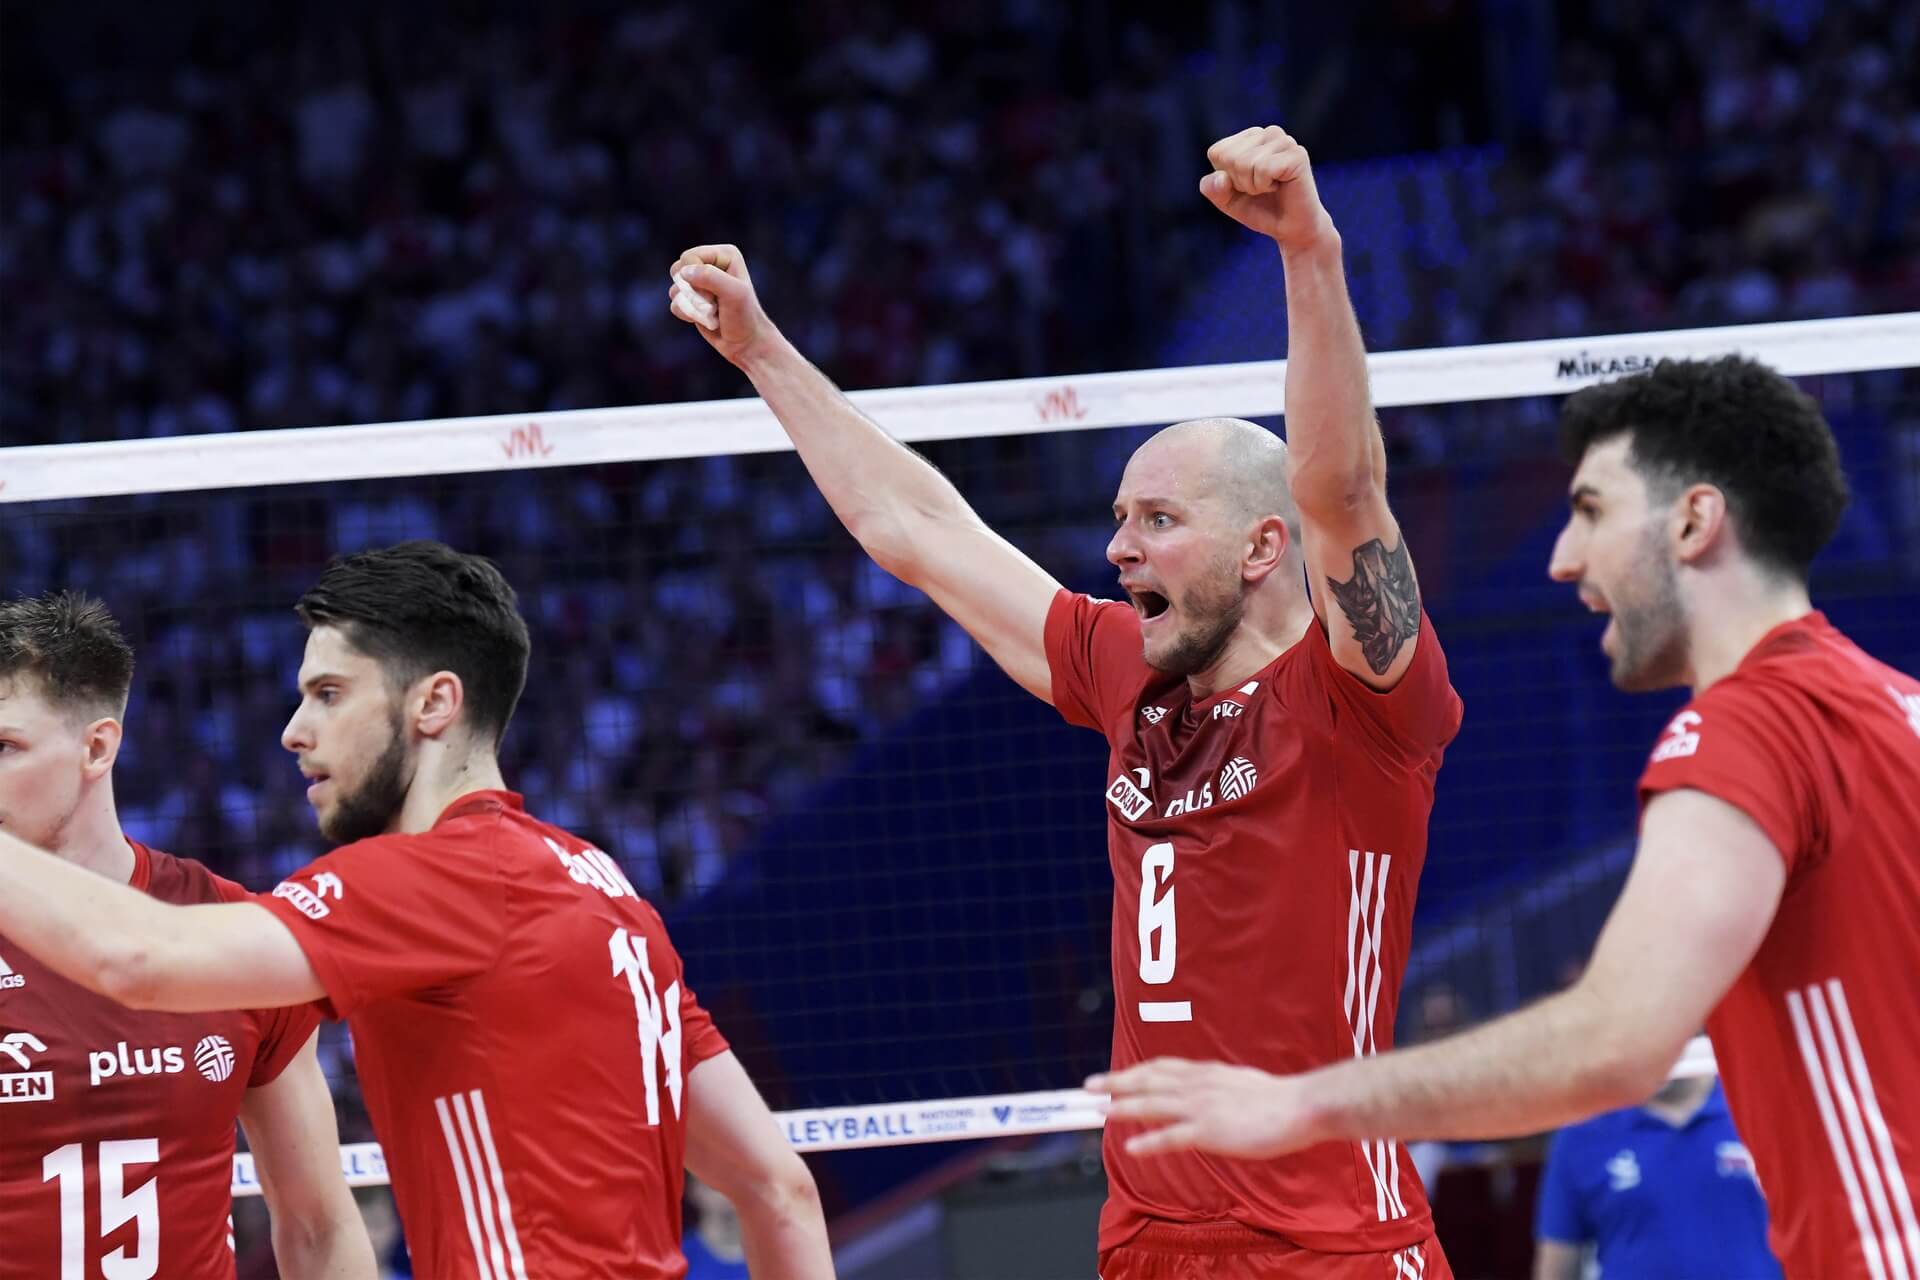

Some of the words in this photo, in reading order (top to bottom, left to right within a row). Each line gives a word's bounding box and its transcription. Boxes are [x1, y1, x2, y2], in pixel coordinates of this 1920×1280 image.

[501, 422, 555, 459] VNL
[1138, 842, 1176, 984] 6
[89, 1042, 185, 1086] plus
[788, 1113, 914, 1143] LEYBALL
[42, 1137, 160, 1280] 15
